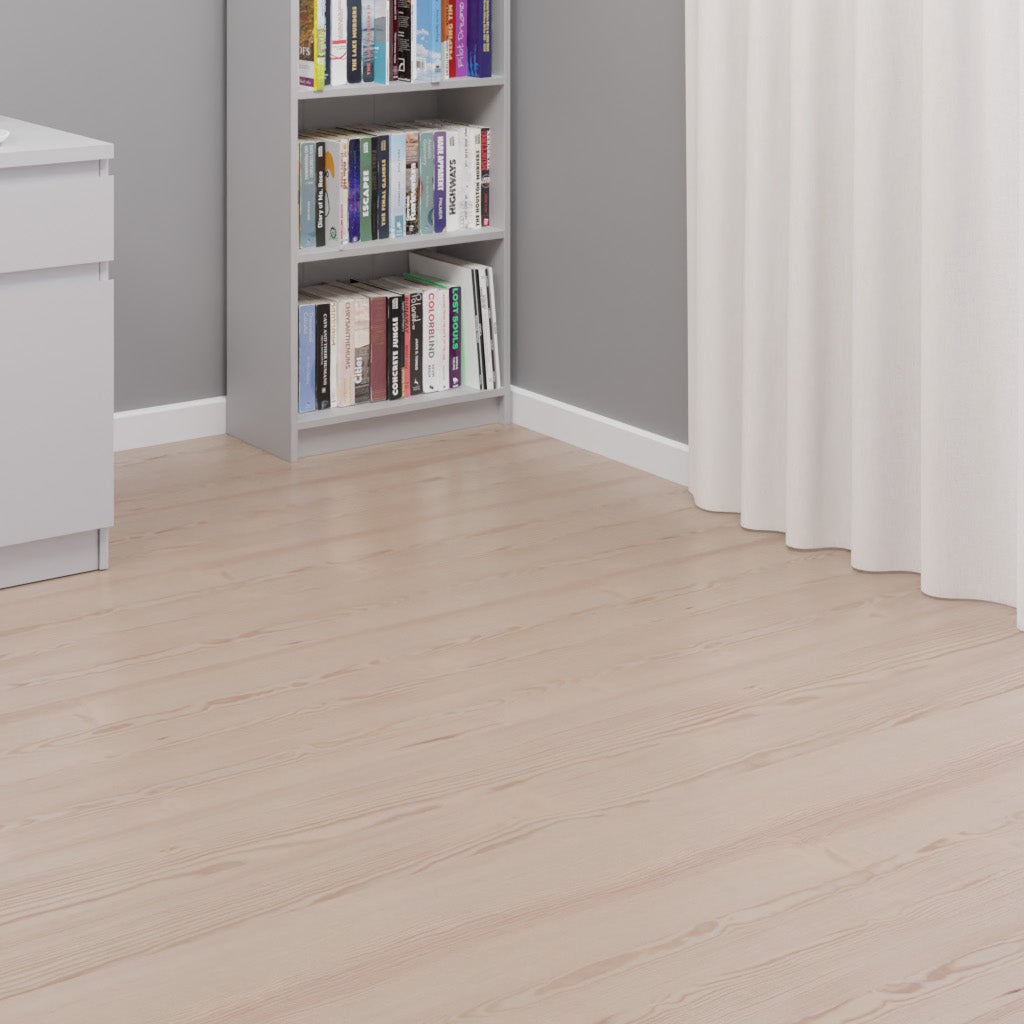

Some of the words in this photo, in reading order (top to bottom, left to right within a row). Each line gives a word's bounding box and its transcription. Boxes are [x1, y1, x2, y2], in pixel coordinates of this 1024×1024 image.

[456, 43, 464, 68] Pilot
[449, 159, 457, 215] HIGHWAYS
[318, 201, 323, 209] of
[354, 357, 362, 384] Cities
